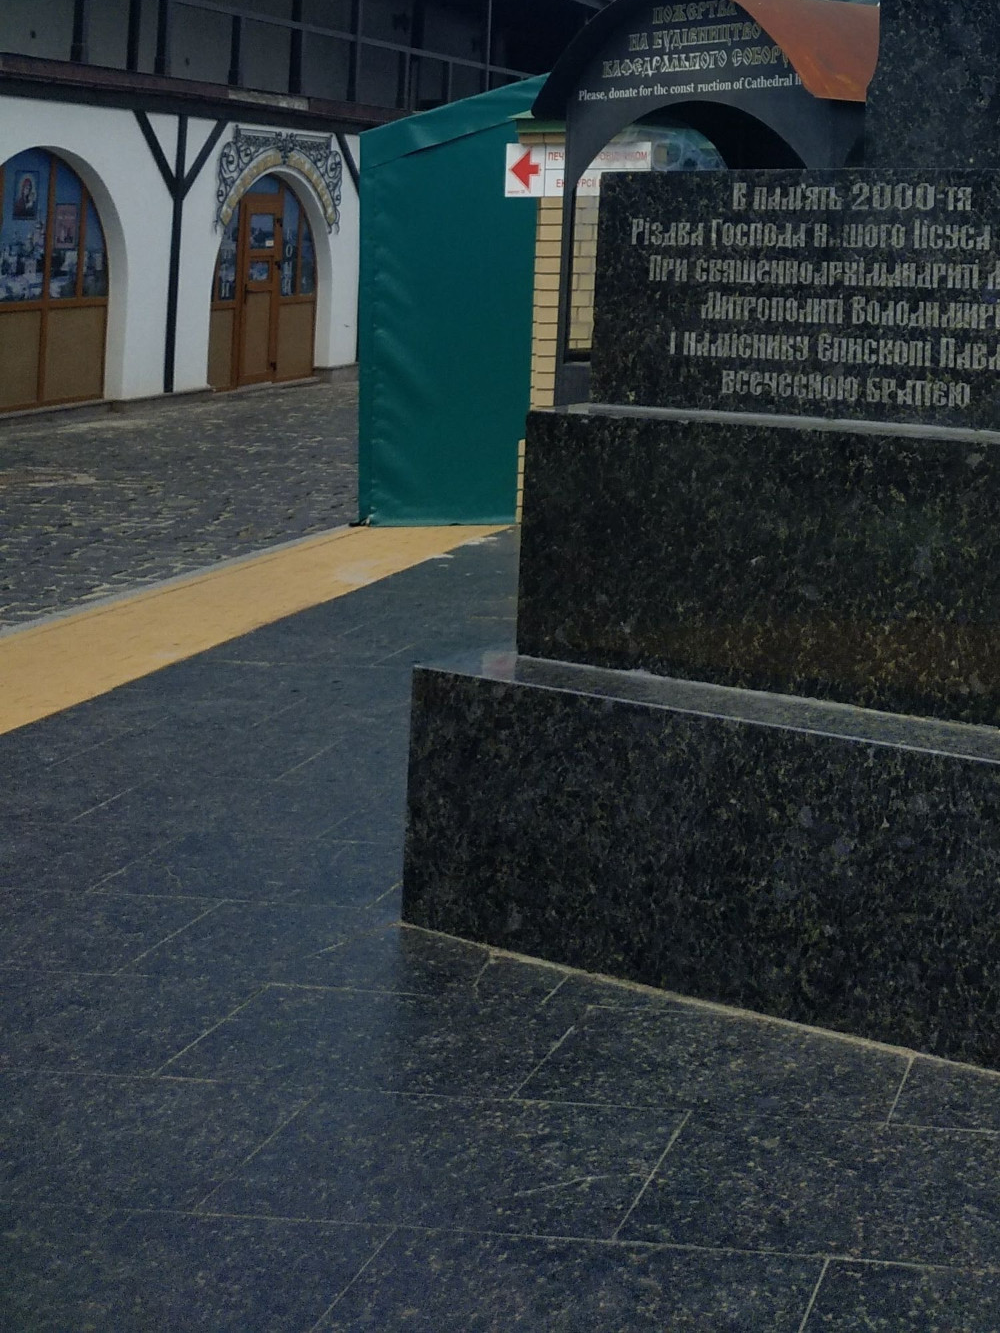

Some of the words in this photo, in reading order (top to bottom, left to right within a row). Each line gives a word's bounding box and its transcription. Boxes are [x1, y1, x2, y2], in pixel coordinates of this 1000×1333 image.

[628, 32, 649, 51] НА
[653, 22, 761, 52] БУДІВНИЦТВО
[578, 89, 607, 101] Please,
[609, 87, 638, 100] donate
[639, 85, 653, 97] for
[733, 78, 745, 90] of
[745, 74, 793, 89] Cathedral
